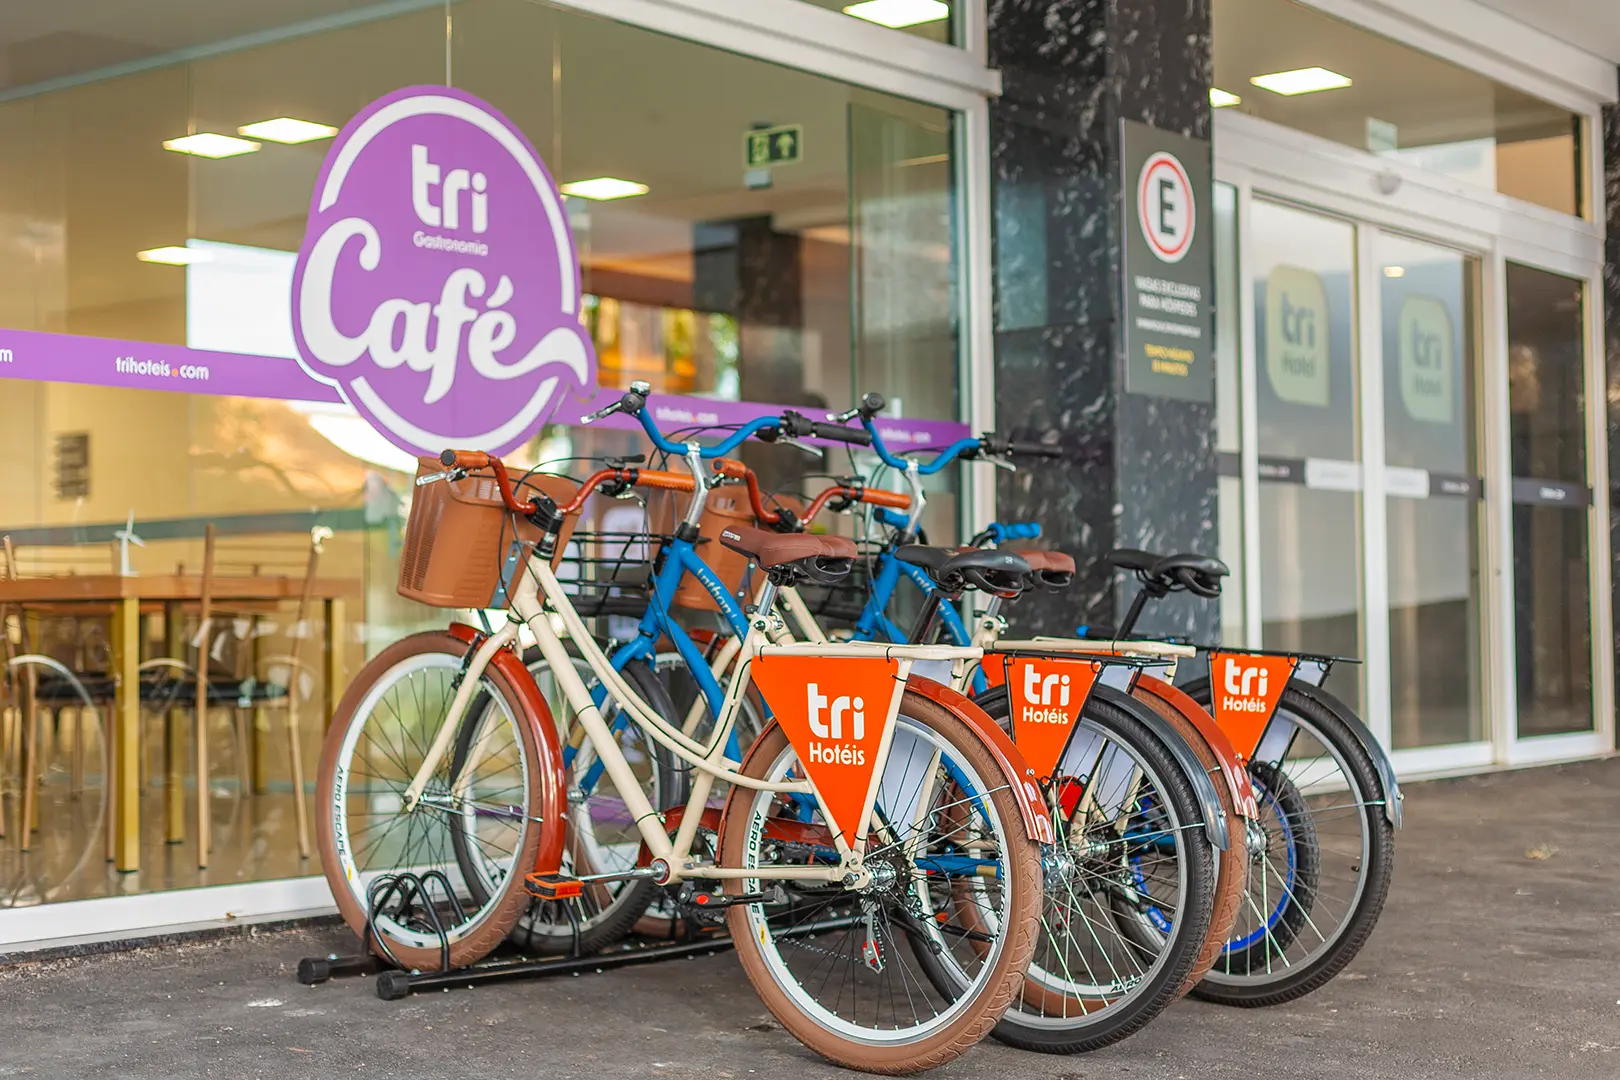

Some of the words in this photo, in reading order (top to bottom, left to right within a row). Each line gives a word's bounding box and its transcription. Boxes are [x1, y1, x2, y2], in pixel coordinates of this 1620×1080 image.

[411, 144, 488, 234] tri
[1160, 179, 1176, 235] E
[412, 230, 489, 257] Gastronomia
[300, 216, 588, 404] Café
[1281, 290, 1314, 349] tri
[115, 356, 210, 381] trihoteis.com
[1024, 663, 1071, 707] tri
[1225, 658, 1268, 697] tri
[807, 682, 865, 740] tri
[1022, 706, 1069, 725] Hotéis
[1223, 696, 1266, 713] Hotéis
[809, 741, 865, 766] Hotéis
[334, 764, 345, 801] AERO
[748, 810, 762, 851] AERO
